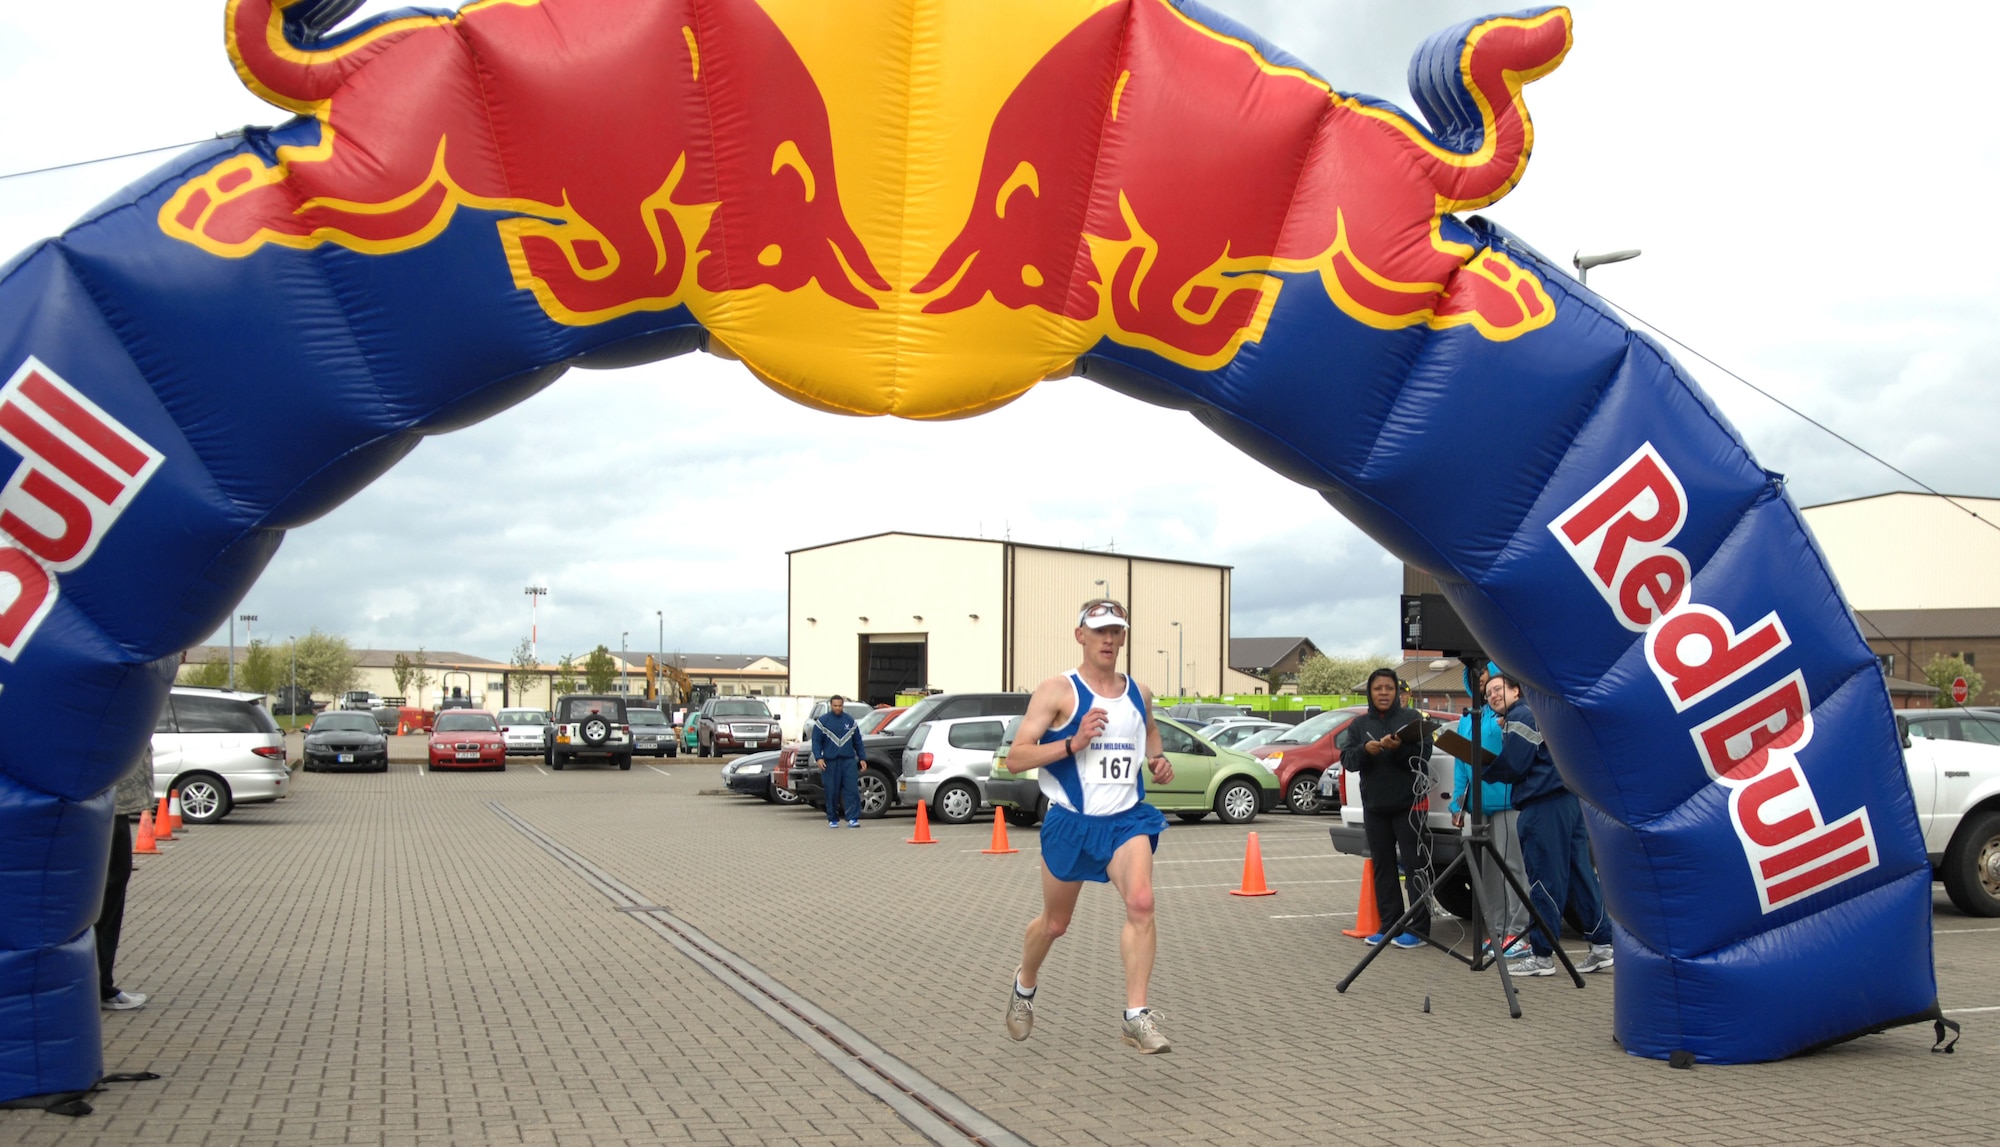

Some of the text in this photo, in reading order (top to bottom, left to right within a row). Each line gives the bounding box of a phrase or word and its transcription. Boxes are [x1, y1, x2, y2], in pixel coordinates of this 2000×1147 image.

[1558, 452, 1873, 906] Red Bull
[1953, 686, 1968, 694] STOP
[1090, 742, 1135, 750] RAF MILDENHALL
[1099, 756, 1132, 779] 167
